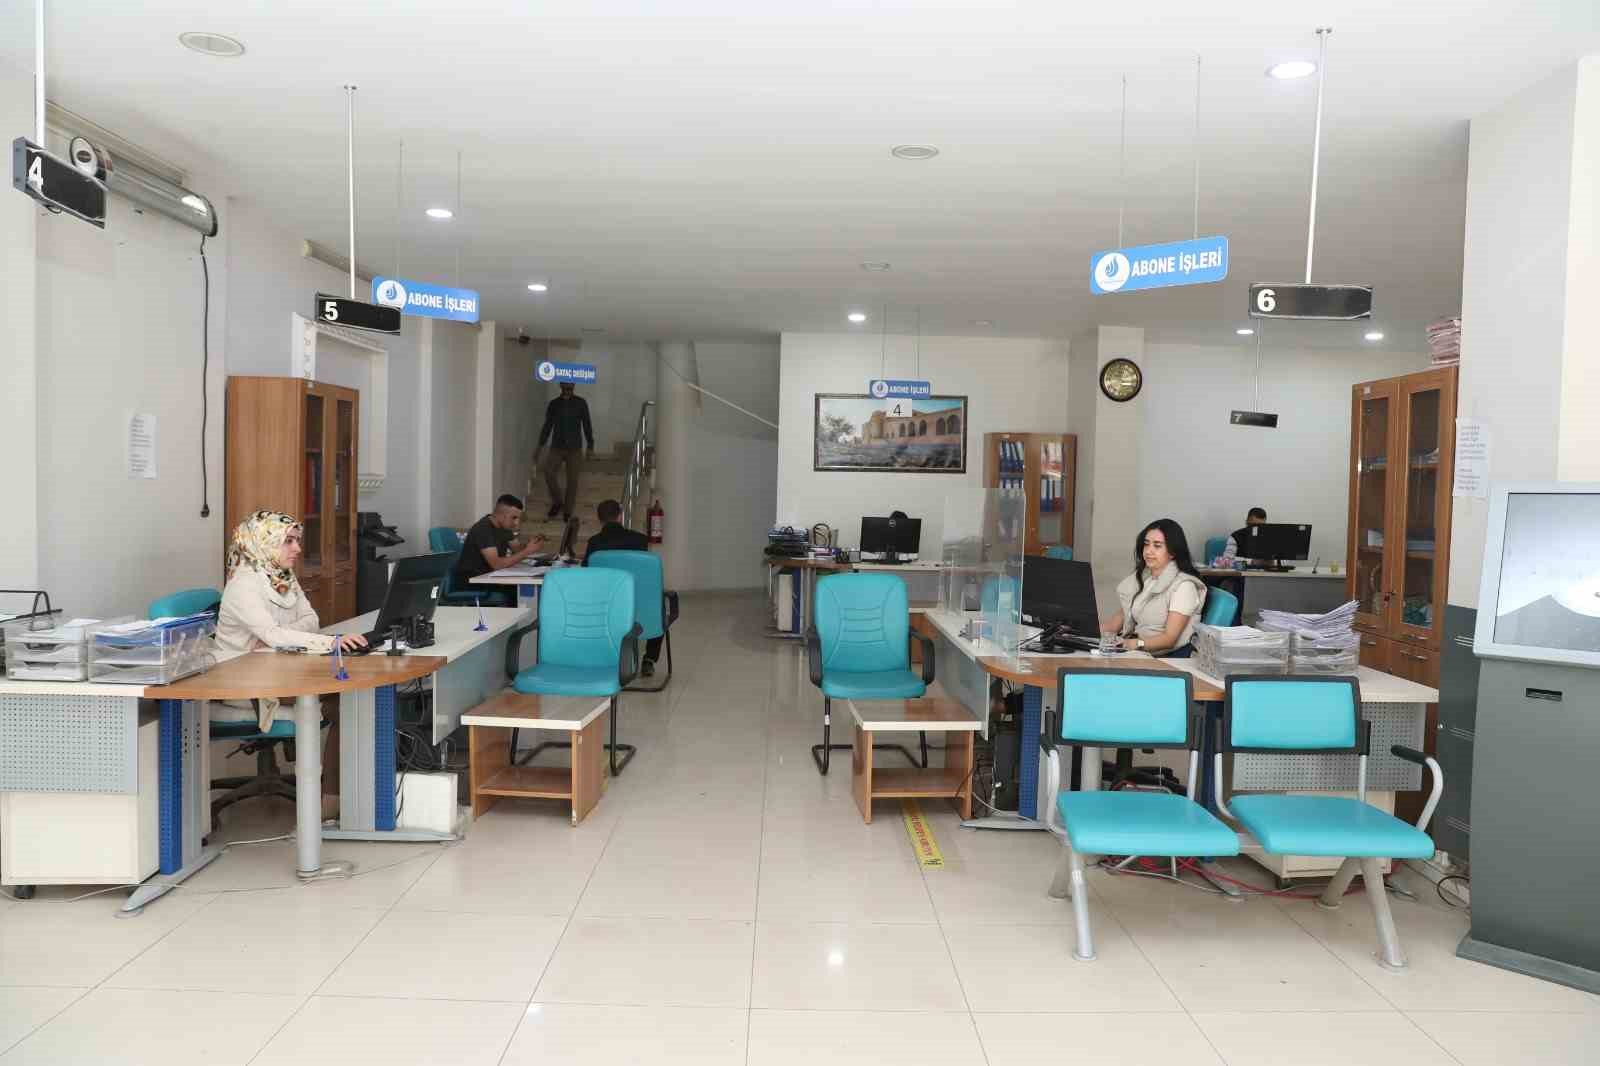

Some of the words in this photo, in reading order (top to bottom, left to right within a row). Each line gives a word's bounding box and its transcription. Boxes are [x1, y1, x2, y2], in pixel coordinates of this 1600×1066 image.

[28, 156, 43, 192] 4
[1131, 256, 1175, 277] ABONE
[1179, 247, 1222, 275] İŞLERİ
[324, 301, 338, 320] 5
[408, 291, 442, 308] ABONE
[445, 295, 476, 313] İŞLERİ
[1256, 289, 1276, 312] 6
[893, 403, 904, 417] 4
[1234, 413, 1242, 423] 7
